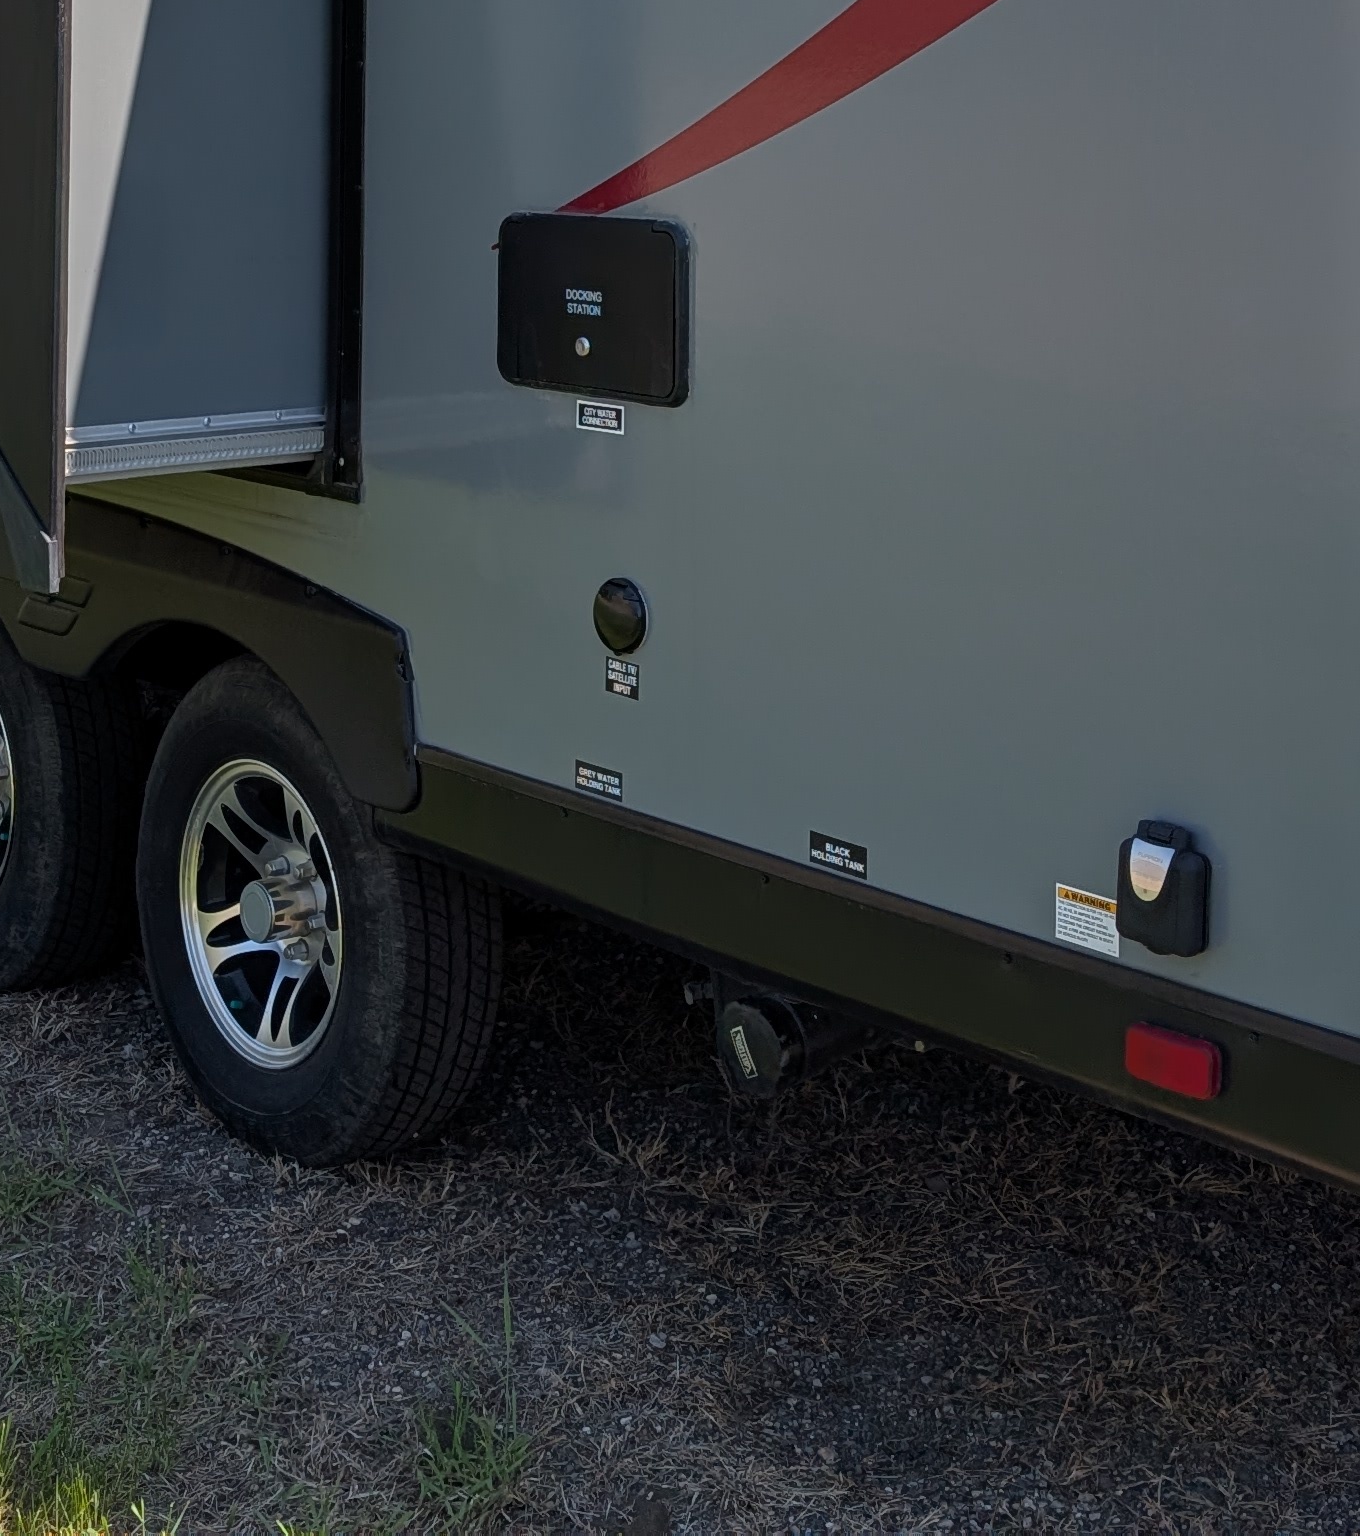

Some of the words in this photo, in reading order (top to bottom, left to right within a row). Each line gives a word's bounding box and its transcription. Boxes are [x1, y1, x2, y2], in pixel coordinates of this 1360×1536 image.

[565, 288, 603, 303] DOCKING
[566, 302, 601, 317] STATION
[583, 406, 597, 417] CITY
[581, 415, 619, 429] CONNECTION
[607, 658, 627, 673] CABLE
[607, 669, 638, 687] SATELLITE
[576, 775, 604, 791] HOLDING
[604, 784, 622, 797] TANK
[597, 772, 620, 786] WATER
[825, 842, 851, 858] BLACK
[811, 848, 844, 867] HOLDING
[844, 858, 865, 874] TANK
[1071, 891, 1111, 912] WARNING
